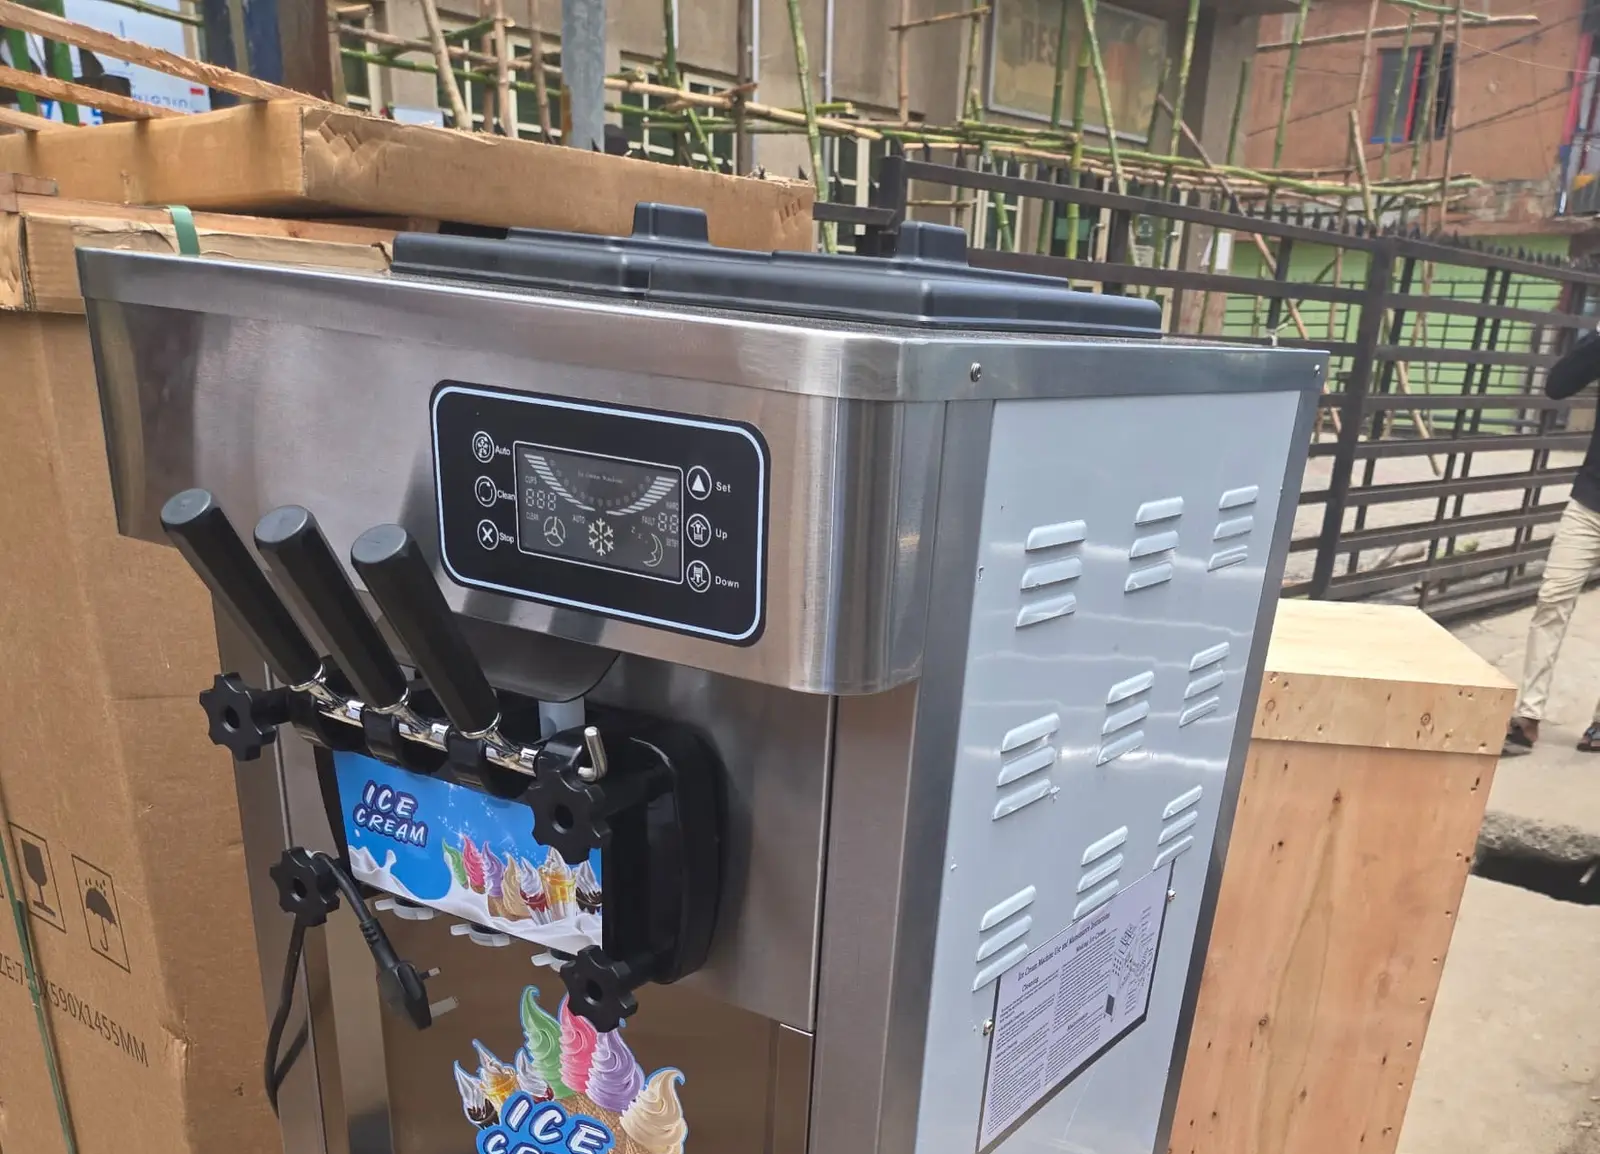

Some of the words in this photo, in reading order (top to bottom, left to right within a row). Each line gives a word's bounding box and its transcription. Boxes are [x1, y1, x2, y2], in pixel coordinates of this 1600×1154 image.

[495, 445, 511, 456] Auto
[716, 481, 731, 493] Set
[497, 490, 516, 501] Clean
[500, 532, 515, 544] Stop
[715, 528, 728, 540] Up
[715, 575, 740, 589] Down
[364, 782, 417, 818] ICE
[355, 806, 426, 845] CREAM
